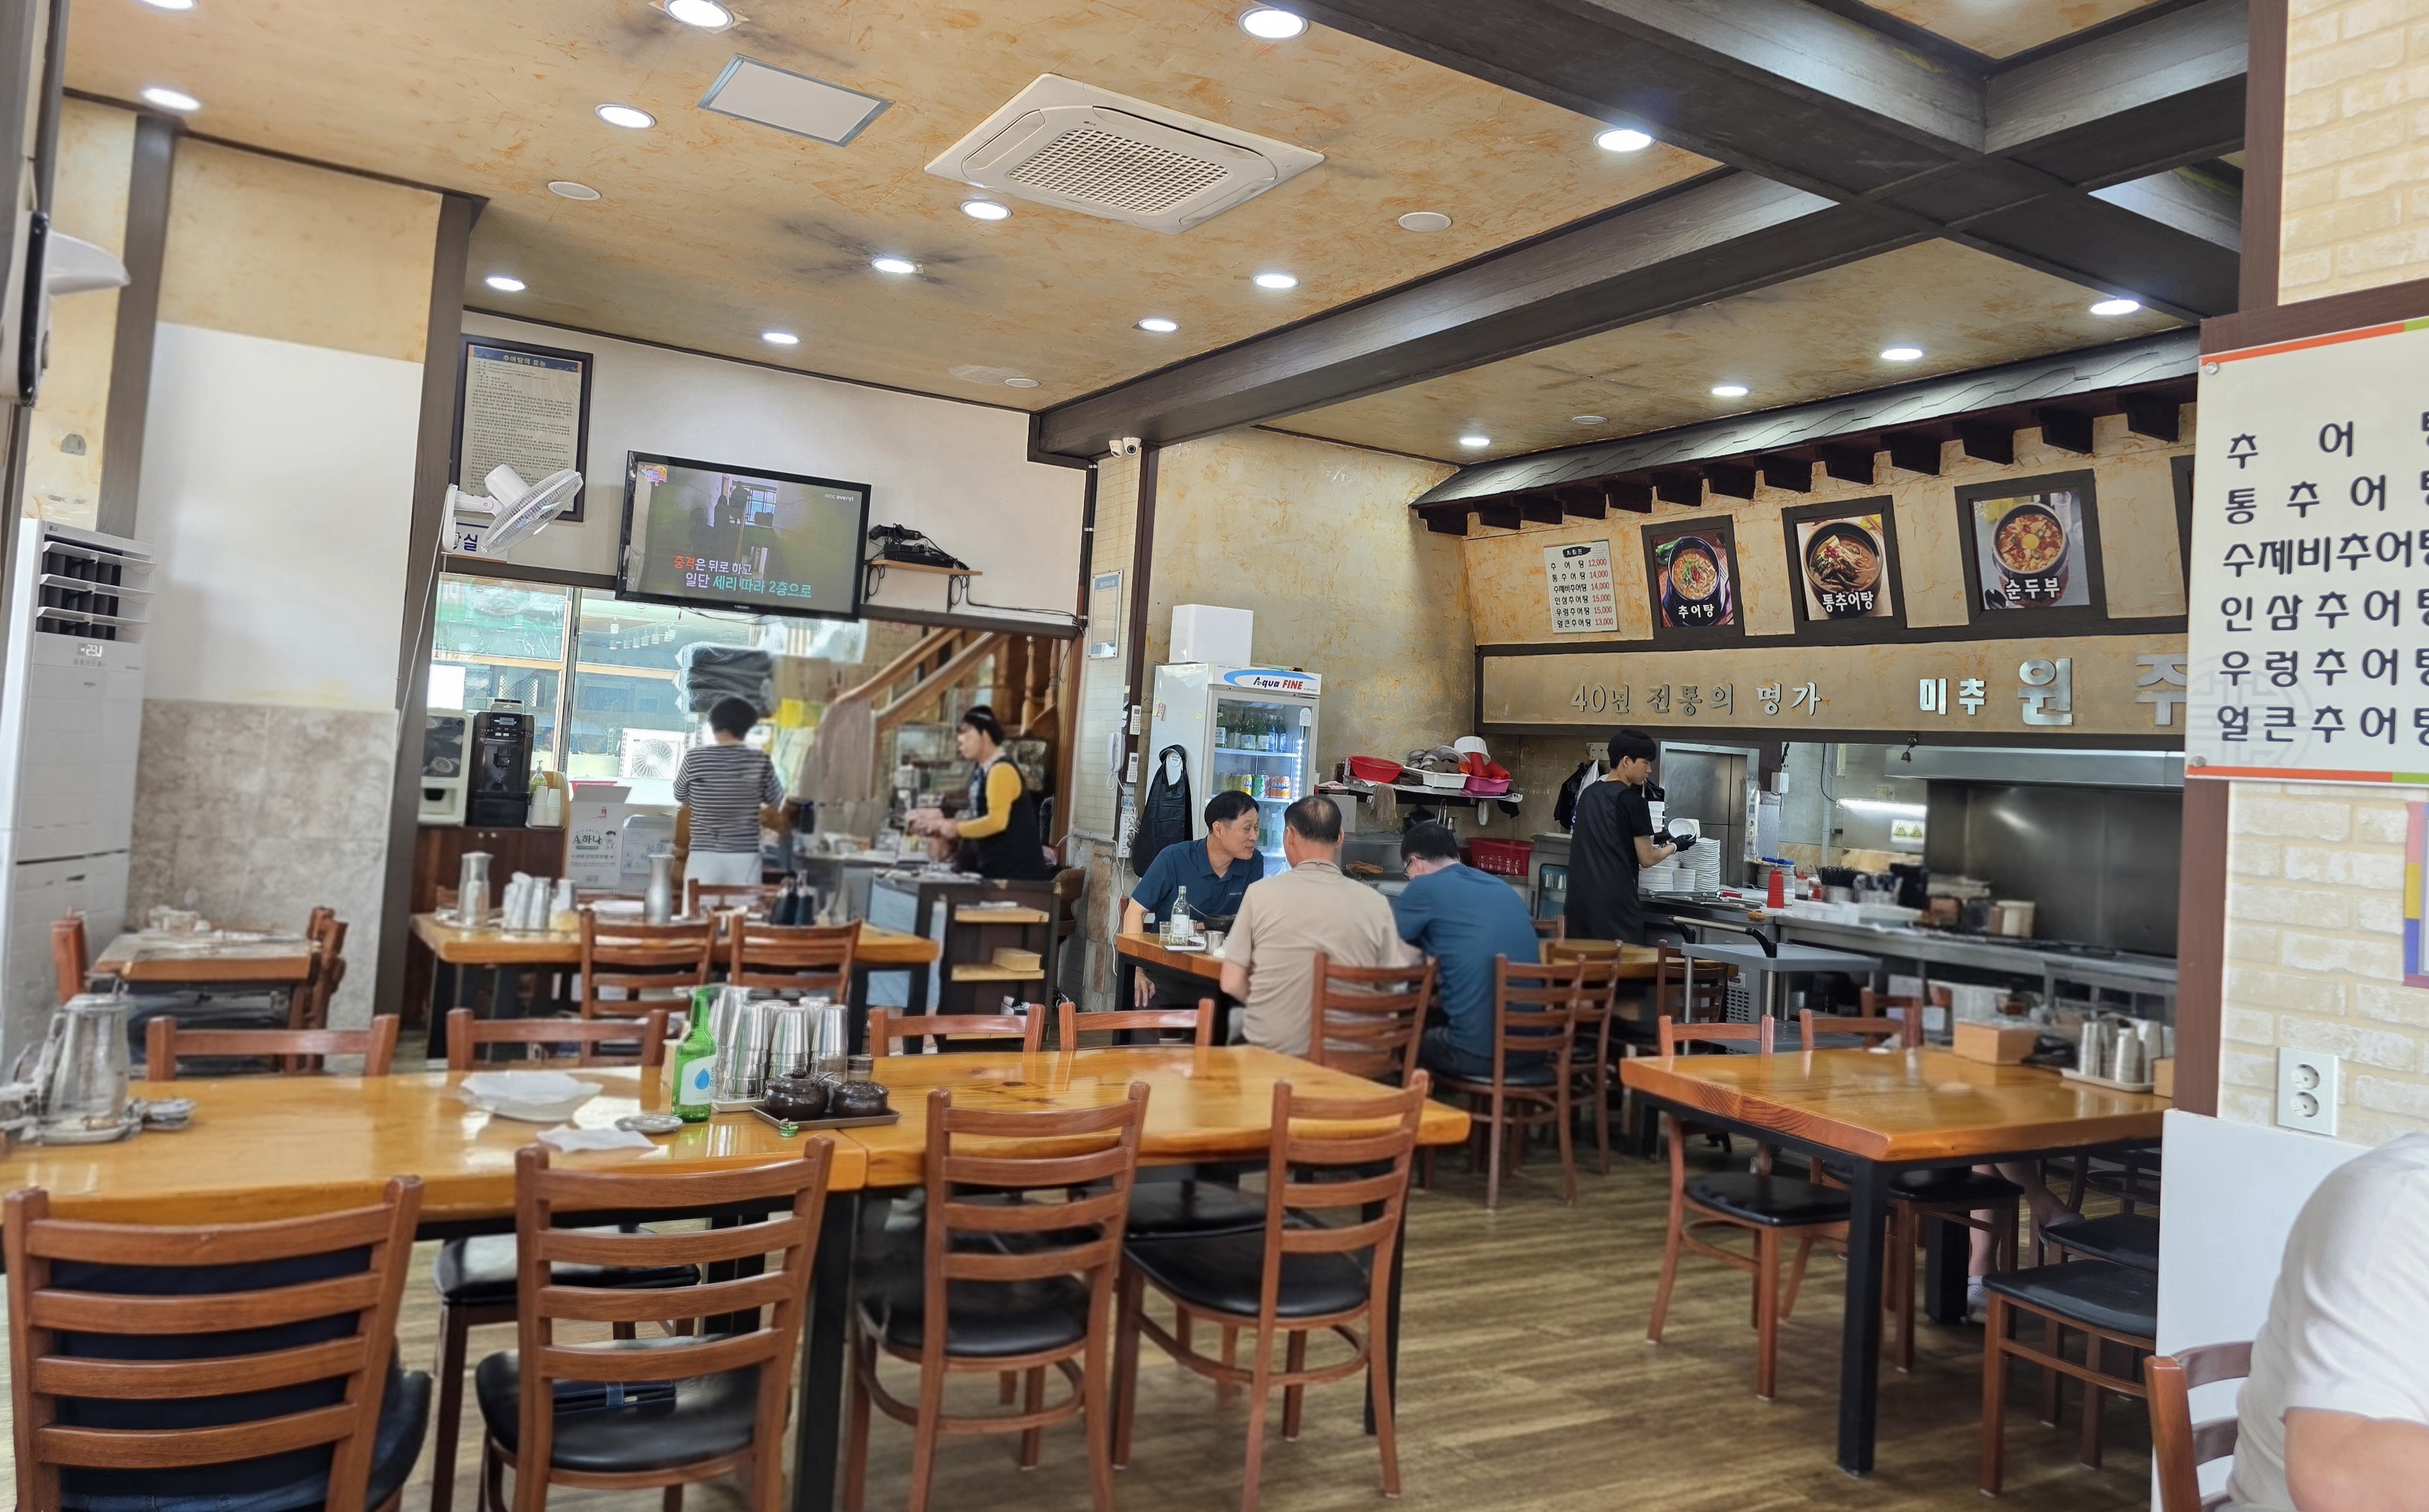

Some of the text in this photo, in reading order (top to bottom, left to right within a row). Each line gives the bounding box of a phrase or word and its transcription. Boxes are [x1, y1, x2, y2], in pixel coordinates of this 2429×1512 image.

[2227, 411, 2429, 469] 추어
[2225, 470, 2429, 525] 통추어
[1588, 558, 1607, 567] 12,000
[2223, 530, 2429, 577] 수제비추어
[673, 555, 752, 576] 충격은 뒤로 하고
[1589, 570, 1609, 579] 14,000
[686, 573, 812, 598] 일단 세리 따라 2층으로
[1591, 582, 1610, 591] 14,000
[2006, 577, 2060, 600] 순두부
[1592, 594, 1611, 602] 15,000
[1822, 591, 1874, 613] 통추어탕
[1678, 604, 1714, 618] 추어탕
[1595, 618, 1613, 626] 13,000
[1253, 677, 1303, 690] Aqua FINE
[1571, 681, 1822, 715] 40년 전통의 명가
[1920, 678, 1986, 715] 미추
[582, 834, 602, 845] 하나
